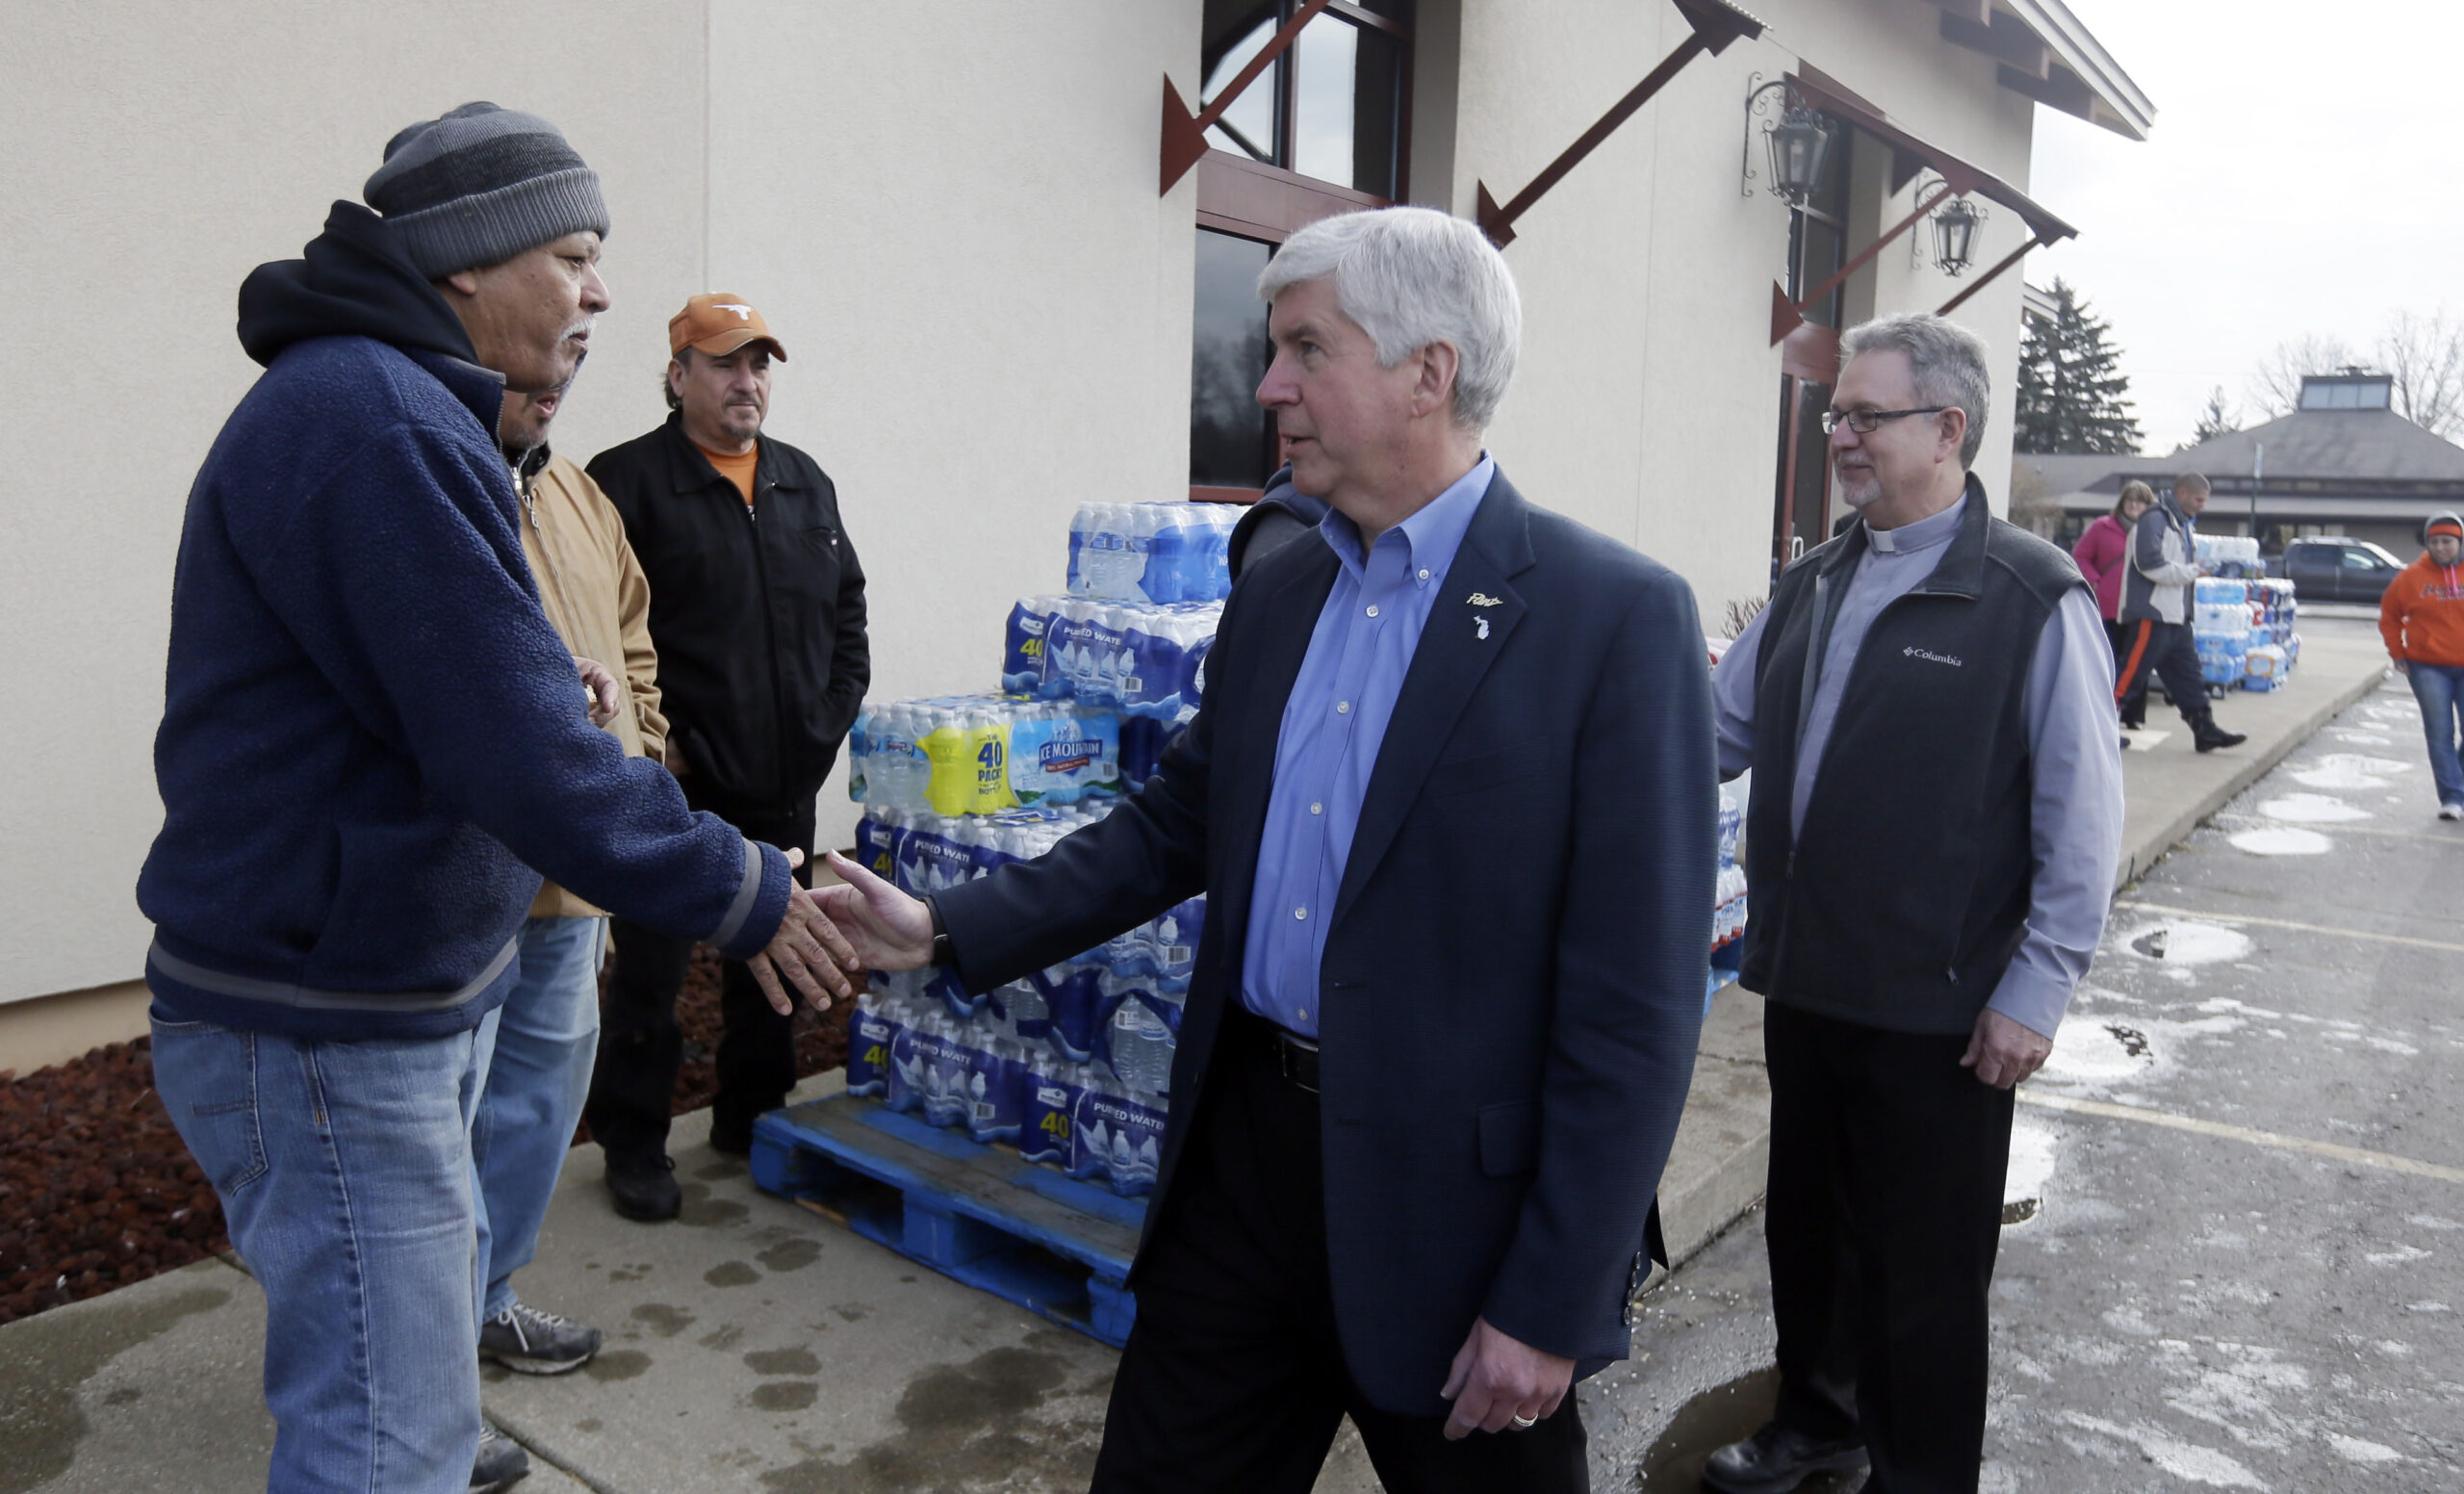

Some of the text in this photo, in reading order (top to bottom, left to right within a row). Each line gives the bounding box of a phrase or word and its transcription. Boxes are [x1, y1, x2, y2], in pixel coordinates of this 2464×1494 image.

[1094, 631, 1121, 645] WATE
[1913, 648, 1962, 666] Columbia
[977, 740, 1003, 768] 40
[1040, 1111, 1069, 1138] 40
[1130, 1113, 1165, 1130] WATE
